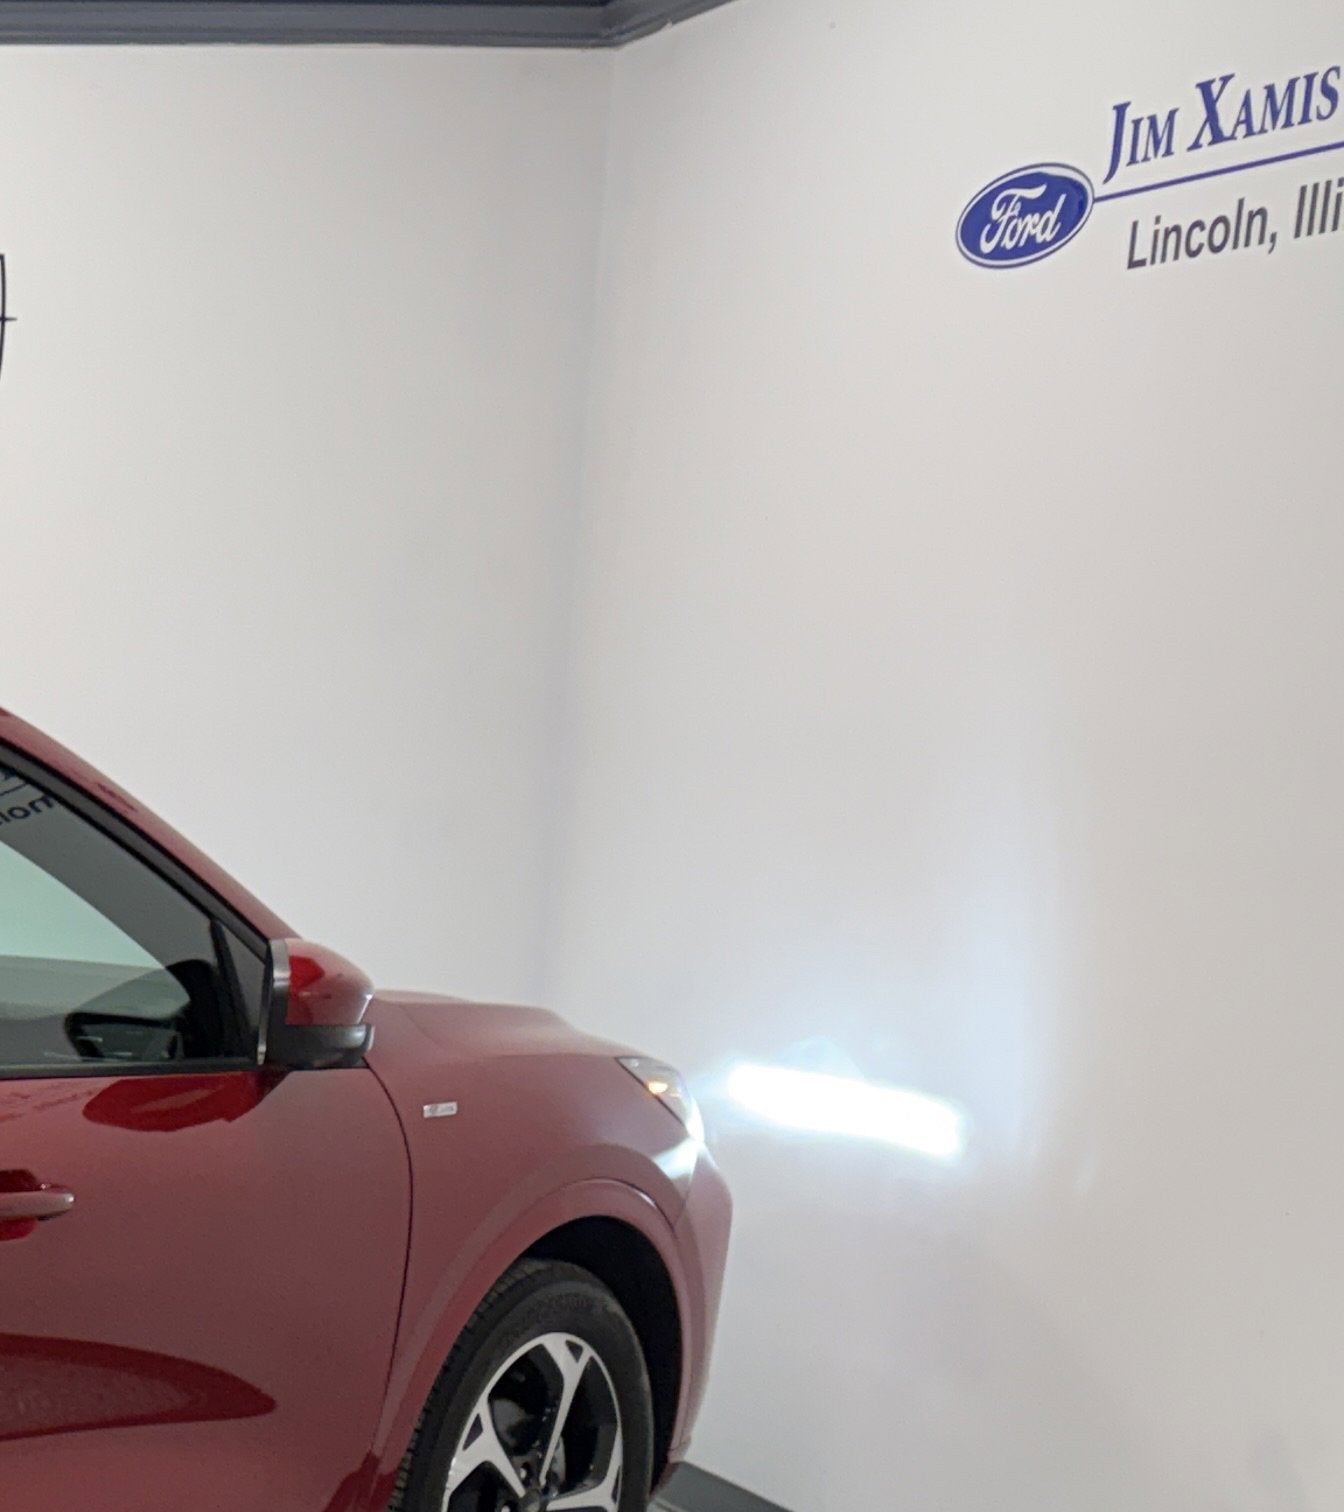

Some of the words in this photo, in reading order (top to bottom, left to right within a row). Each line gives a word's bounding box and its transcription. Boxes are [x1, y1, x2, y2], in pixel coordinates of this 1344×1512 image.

[1103, 101, 1179, 184] JIM
[1186, 65, 1342, 152] XAMIS
[979, 183, 1066, 255] Ford
[1126, 197, 1278, 270] Lincoln,
